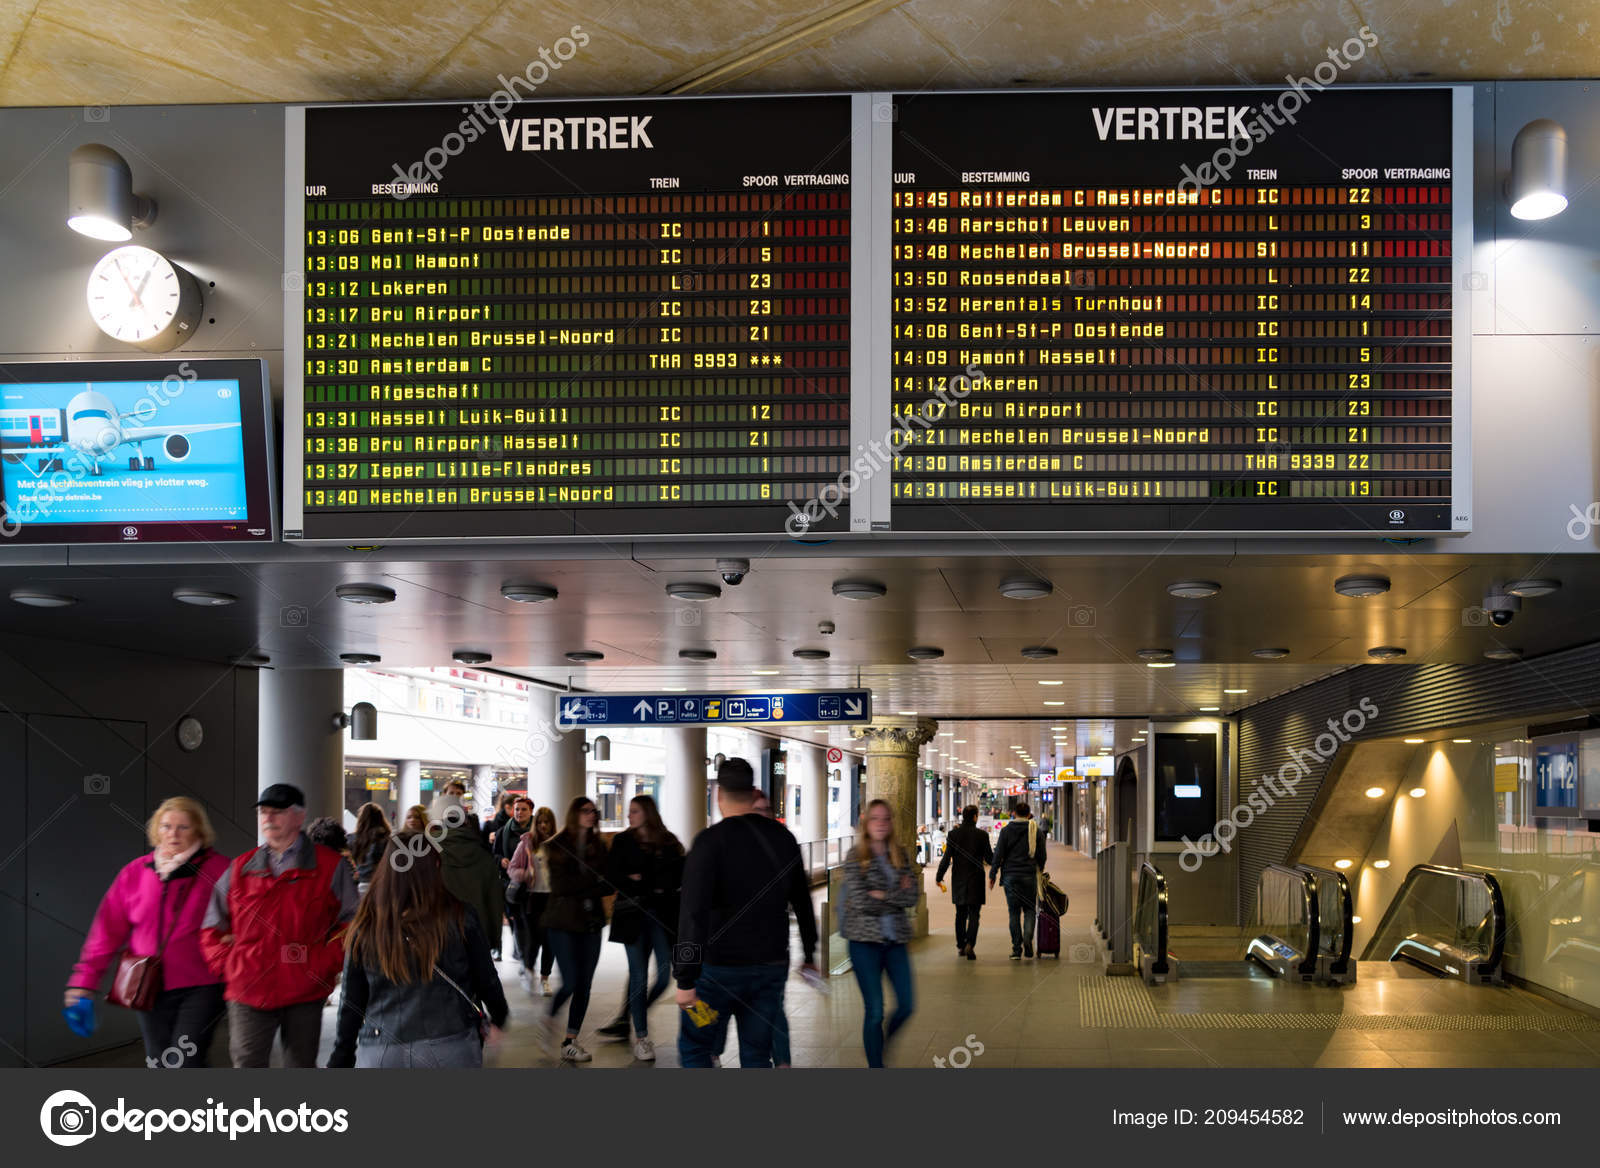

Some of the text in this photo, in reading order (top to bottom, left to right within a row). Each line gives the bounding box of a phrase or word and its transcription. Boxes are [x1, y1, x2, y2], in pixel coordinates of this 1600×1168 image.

[1092, 106, 1251, 141] VERTREK
[499, 116, 654, 151] VERTREK
[306, 174, 849, 196] UUR BESTEMMING TREIN SPOOR VERTRAGING
[894, 168, 1450, 184] UUR BESTEMMING TREIN SPOOR VERTRAGING
[895, 188, 1370, 207] 13:45 Rotterdam C Amsterdam C IC 22
[308, 221, 769, 245] 13:06 Gent-St-P Oostende IC 1
[895, 215, 1371, 233] 13:46 Aarschot Leuven L 3
[307, 247, 771, 271] 13:09 Mol Hamont IC 5
[895, 241, 1368, 260] 13:48 Mechelen Brussel-Noord S1 11
[307, 273, 771, 297] 13:12 Lokeren L 23
[895, 268, 1370, 286] 13:50 Roosendaal L 22
[307, 300, 771, 323] 13:17 Bru Airport IC 23
[895, 294, 1370, 312] 13:52 Herentals Turnhout IC 14
[307, 326, 768, 349] 13:21 Mechelen Brussel-Noord IC 21
[895, 321, 1368, 339] 14:06 Gent-St-P Oostende IC 1
[307, 353, 737, 375] 13:30 Amsterdam C THA 9993
[894, 348, 1370, 365] 14:09 Hamont Hasselt IC 5
[370, 383, 478, 401] Afgeschaft
[895, 374, 1370, 392] 14:12 Lokeren L 23
[307, 405, 770, 427] 13:31 Hasselt Luik-Guill IC 12
[894, 401, 1370, 419] 14:17 Bru Airport IC 23
[306, 431, 768, 453] 13:36 Bru Airport Hasselt IC 21
[894, 427, 1367, 444] 14:21 Mechelen Brussel-Noord IC 21
[306, 457, 768, 479] 13:37 Ieper Lille-Flandres IC 1
[894, 454, 1369, 471] 14:30 Amsterdam C THA 9339 22
[17, 480, 35, 489] Met
[37, 480, 48, 488] de
[121, 479, 143, 489] vlieg
[145, 479, 153, 489] je
[155, 478, 185, 487] vlotter
[187, 479, 208, 488] weg.
[894, 481, 1369, 497] 14:31 Hasselt Luik-Guill IC 13
[306, 483, 770, 505] 13:40 Mechelen Brussel-Noord IC 6
